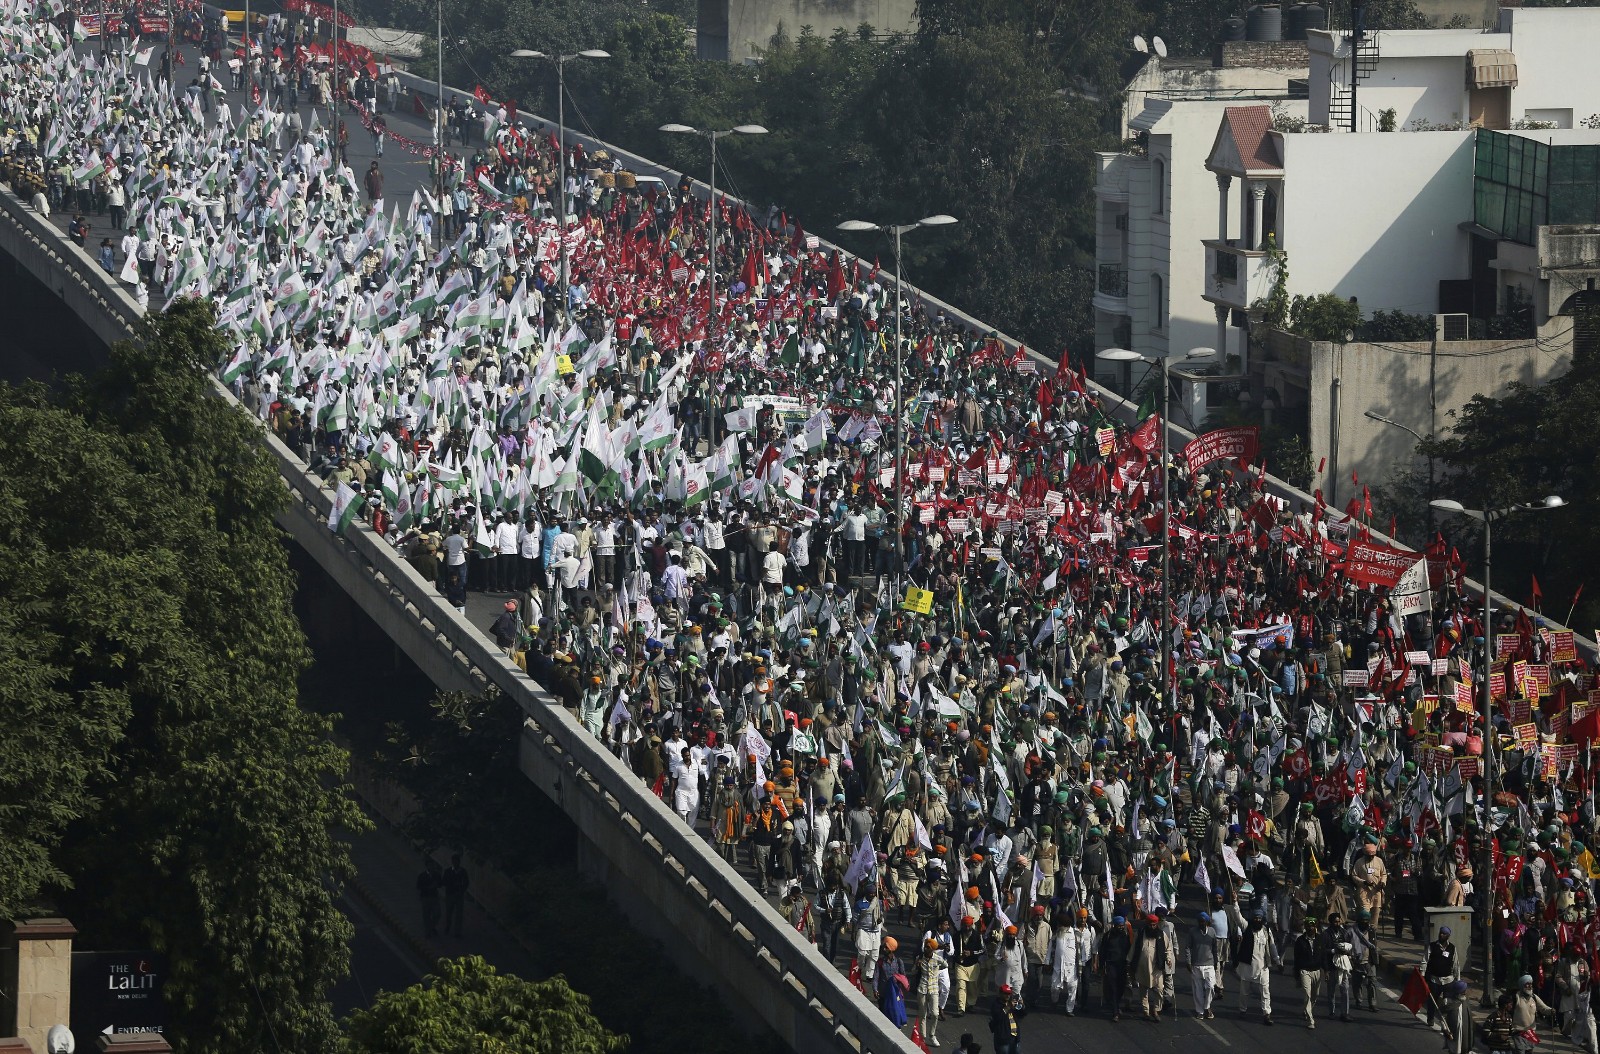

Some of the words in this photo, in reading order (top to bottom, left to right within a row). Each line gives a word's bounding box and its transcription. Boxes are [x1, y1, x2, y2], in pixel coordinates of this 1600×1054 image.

[1356, 770, 1365, 794] AIKS
[1508, 856, 1521, 880] AIKS
[110, 965, 129, 973] THE
[117, 1026, 163, 1034] ENTRANCE
